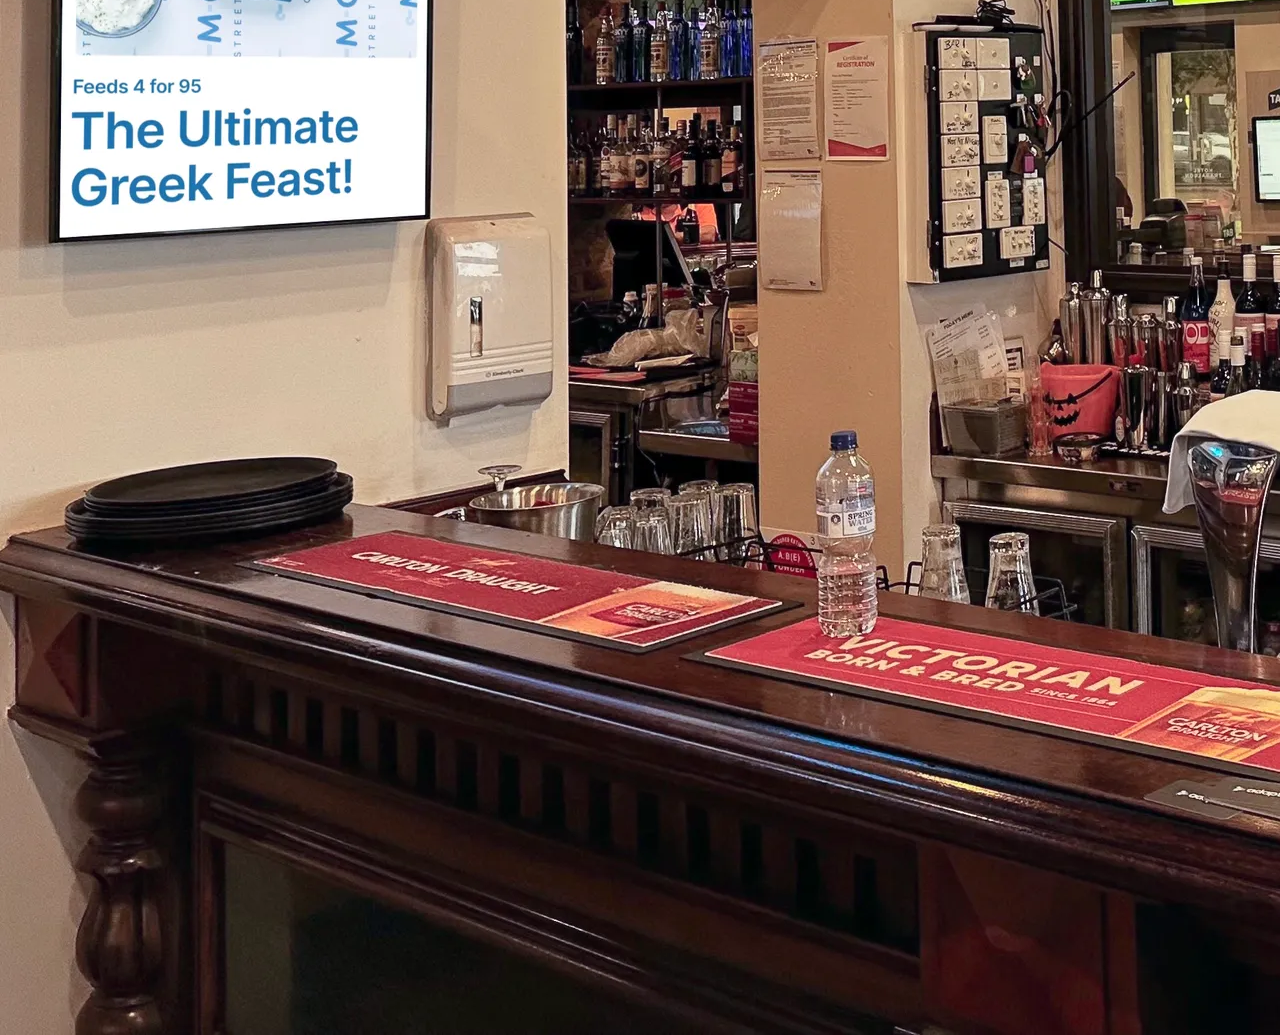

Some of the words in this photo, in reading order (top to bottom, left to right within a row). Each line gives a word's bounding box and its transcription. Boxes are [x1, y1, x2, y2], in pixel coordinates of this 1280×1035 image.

[73, 78, 128, 94] Feeds
[133, 78, 145, 93] 4
[149, 78, 174, 93] for
[178, 78, 201, 93] 95
[71, 109, 164, 150] The
[179, 104, 358, 148] Ultimate
[71, 162, 213, 207] Greek
[226, 158, 352, 199] Feast!
[847, 509, 874, 521] SPRING
[848, 517, 874, 527] WATER
[810, 537, 816, 546] 3
[351, 551, 450, 574] CARLTON
[442, 568, 560, 595] DRAUGHT
[803, 648, 902, 672] BORN
[899, 665, 927, 677] &
[930, 669, 1025, 693] BRED
[1030, 687, 1080, 702] SINCE
[1080, 696, 1120, 708] 1864
[837, 635, 1145, 696] VICTORIAN
[1167, 717, 1268, 743] CARLTON
[1167, 725, 1247, 745] DRAUGHT
